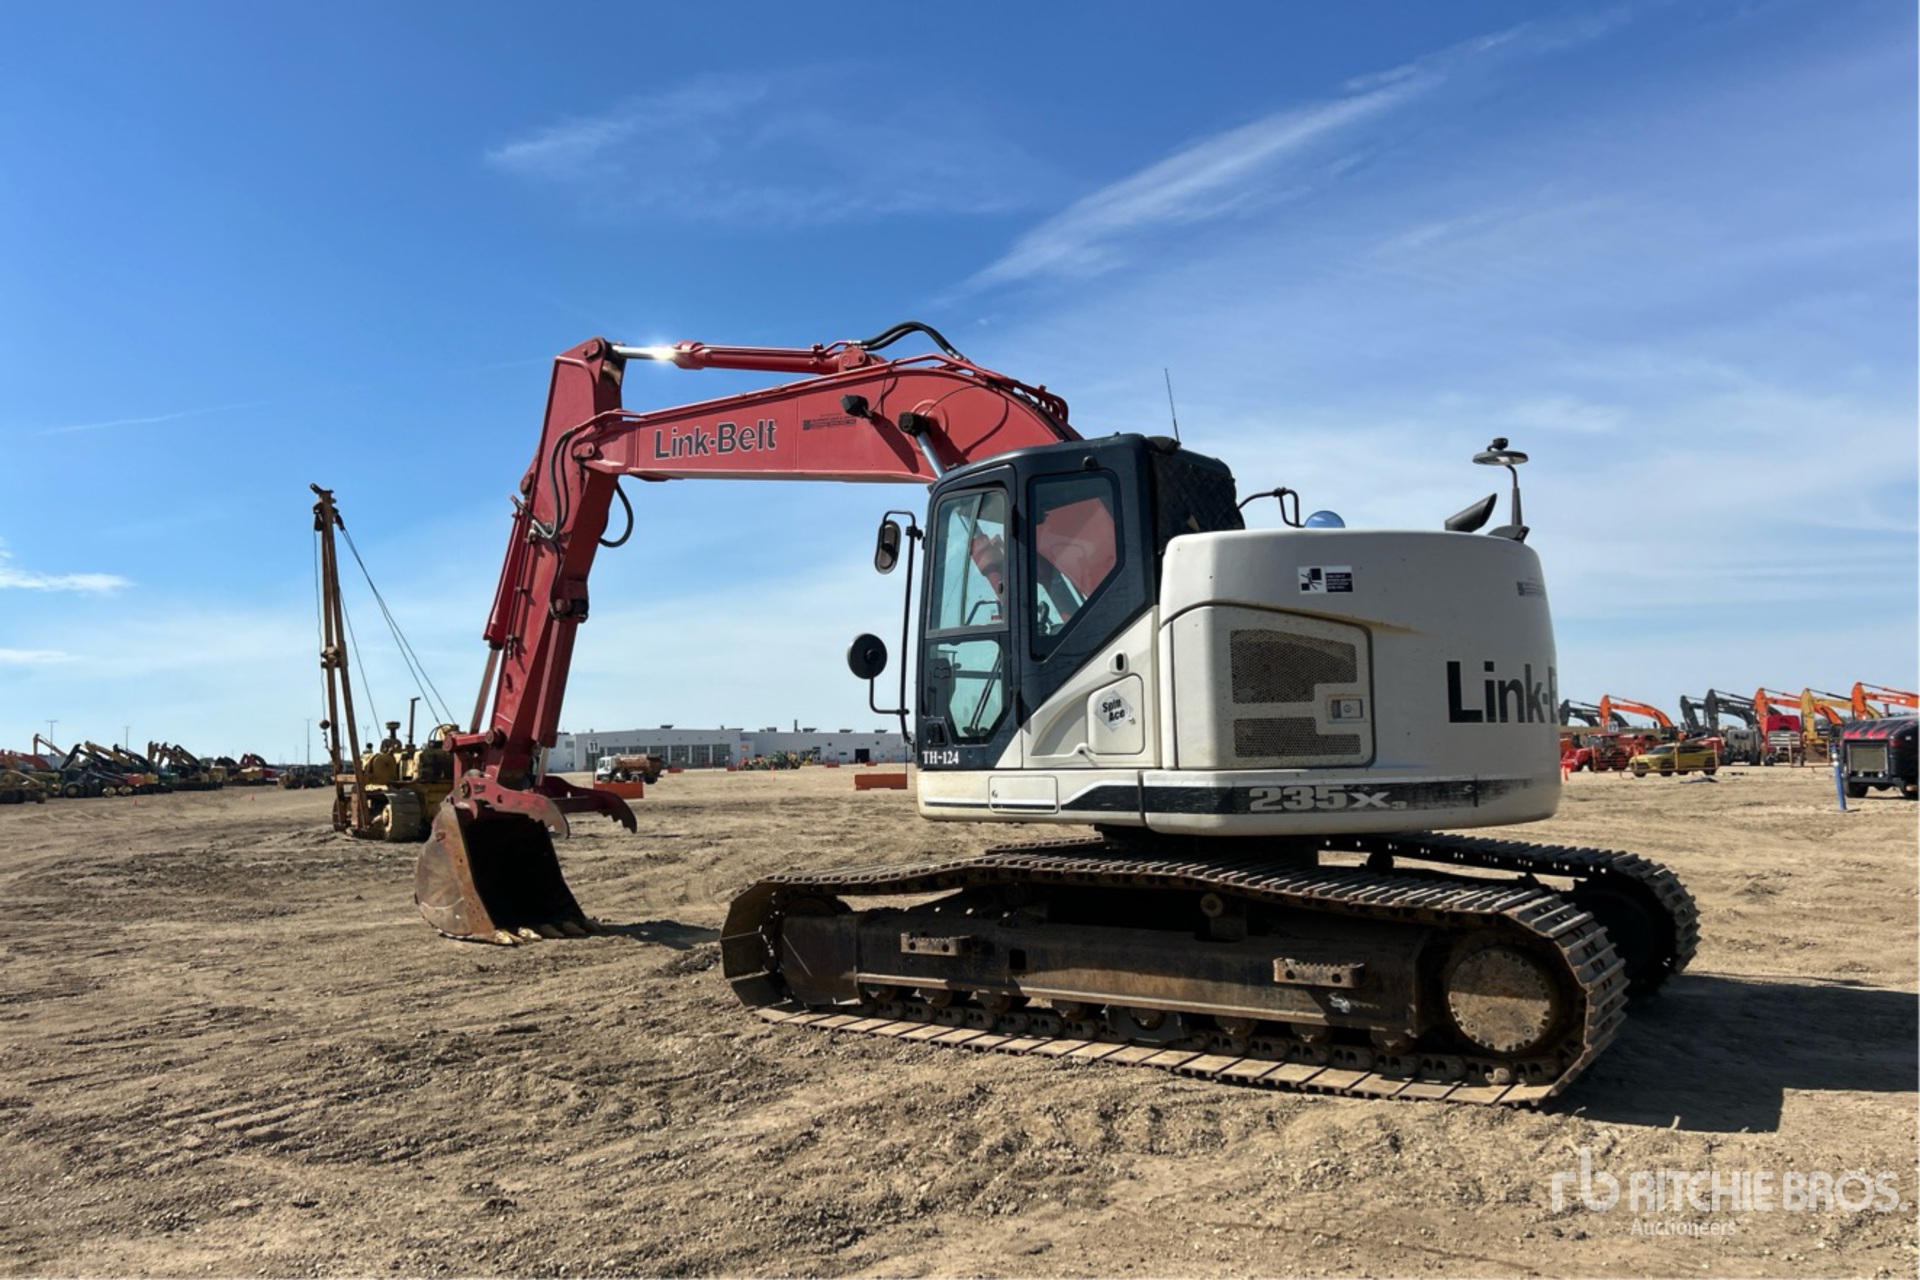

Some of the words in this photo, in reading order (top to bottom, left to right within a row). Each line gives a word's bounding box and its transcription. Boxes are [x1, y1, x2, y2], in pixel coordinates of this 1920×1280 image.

[1102, 699, 1122, 713] Spin
[1109, 709, 1126, 722] Ace
[922, 750, 959, 765] TH-124
